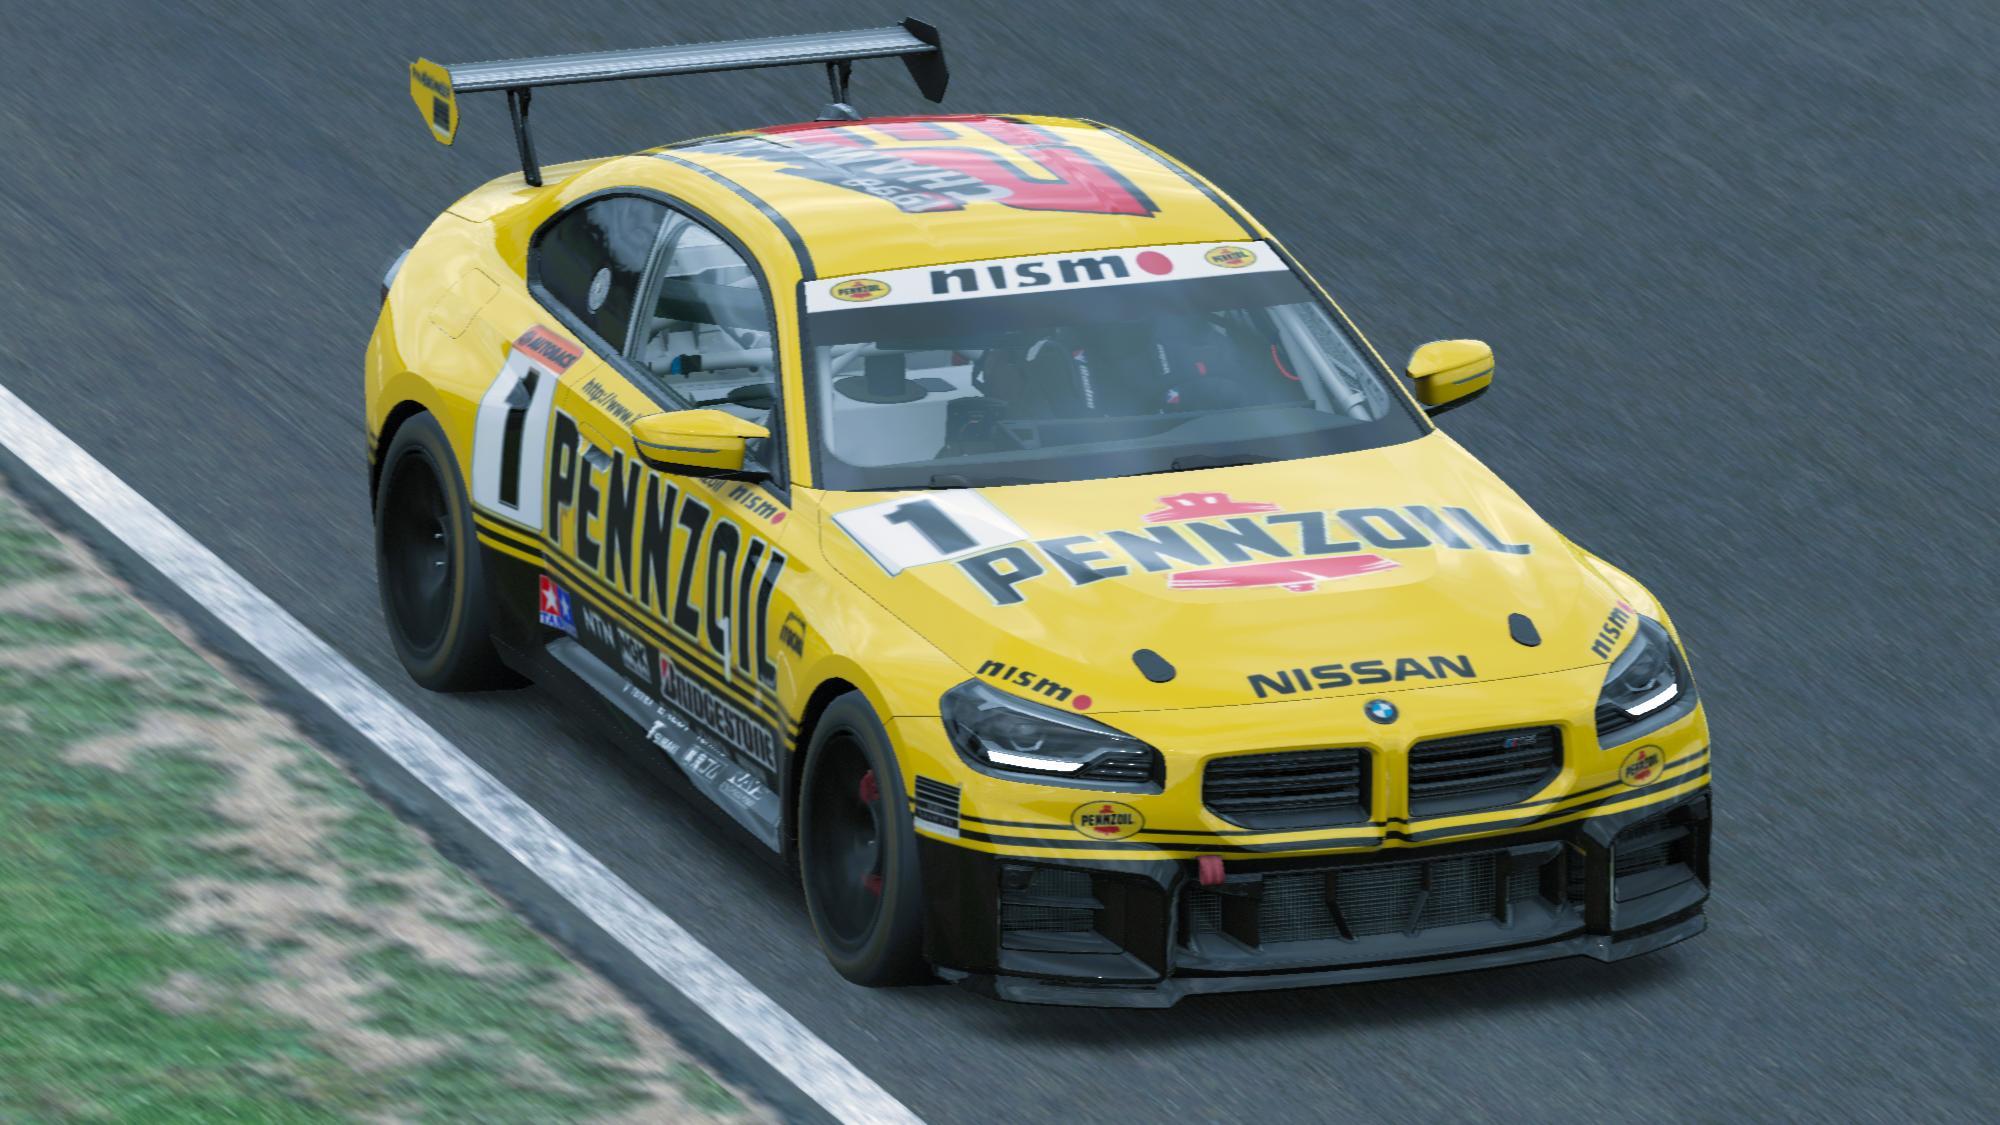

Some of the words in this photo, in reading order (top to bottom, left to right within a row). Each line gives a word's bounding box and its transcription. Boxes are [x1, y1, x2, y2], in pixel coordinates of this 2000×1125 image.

[837, 284, 883, 296] PENNZOIL
[498, 365, 541, 510] 1
[551, 409, 786, 688] PENNZOIL
[885, 498, 979, 556] 1
[955, 505, 1531, 605] PENNZOIL
[662, 655, 774, 769] BRIDGESTONE
[1246, 655, 1476, 698] NISSAN
[1081, 813, 1134, 826] PENNZOIL
